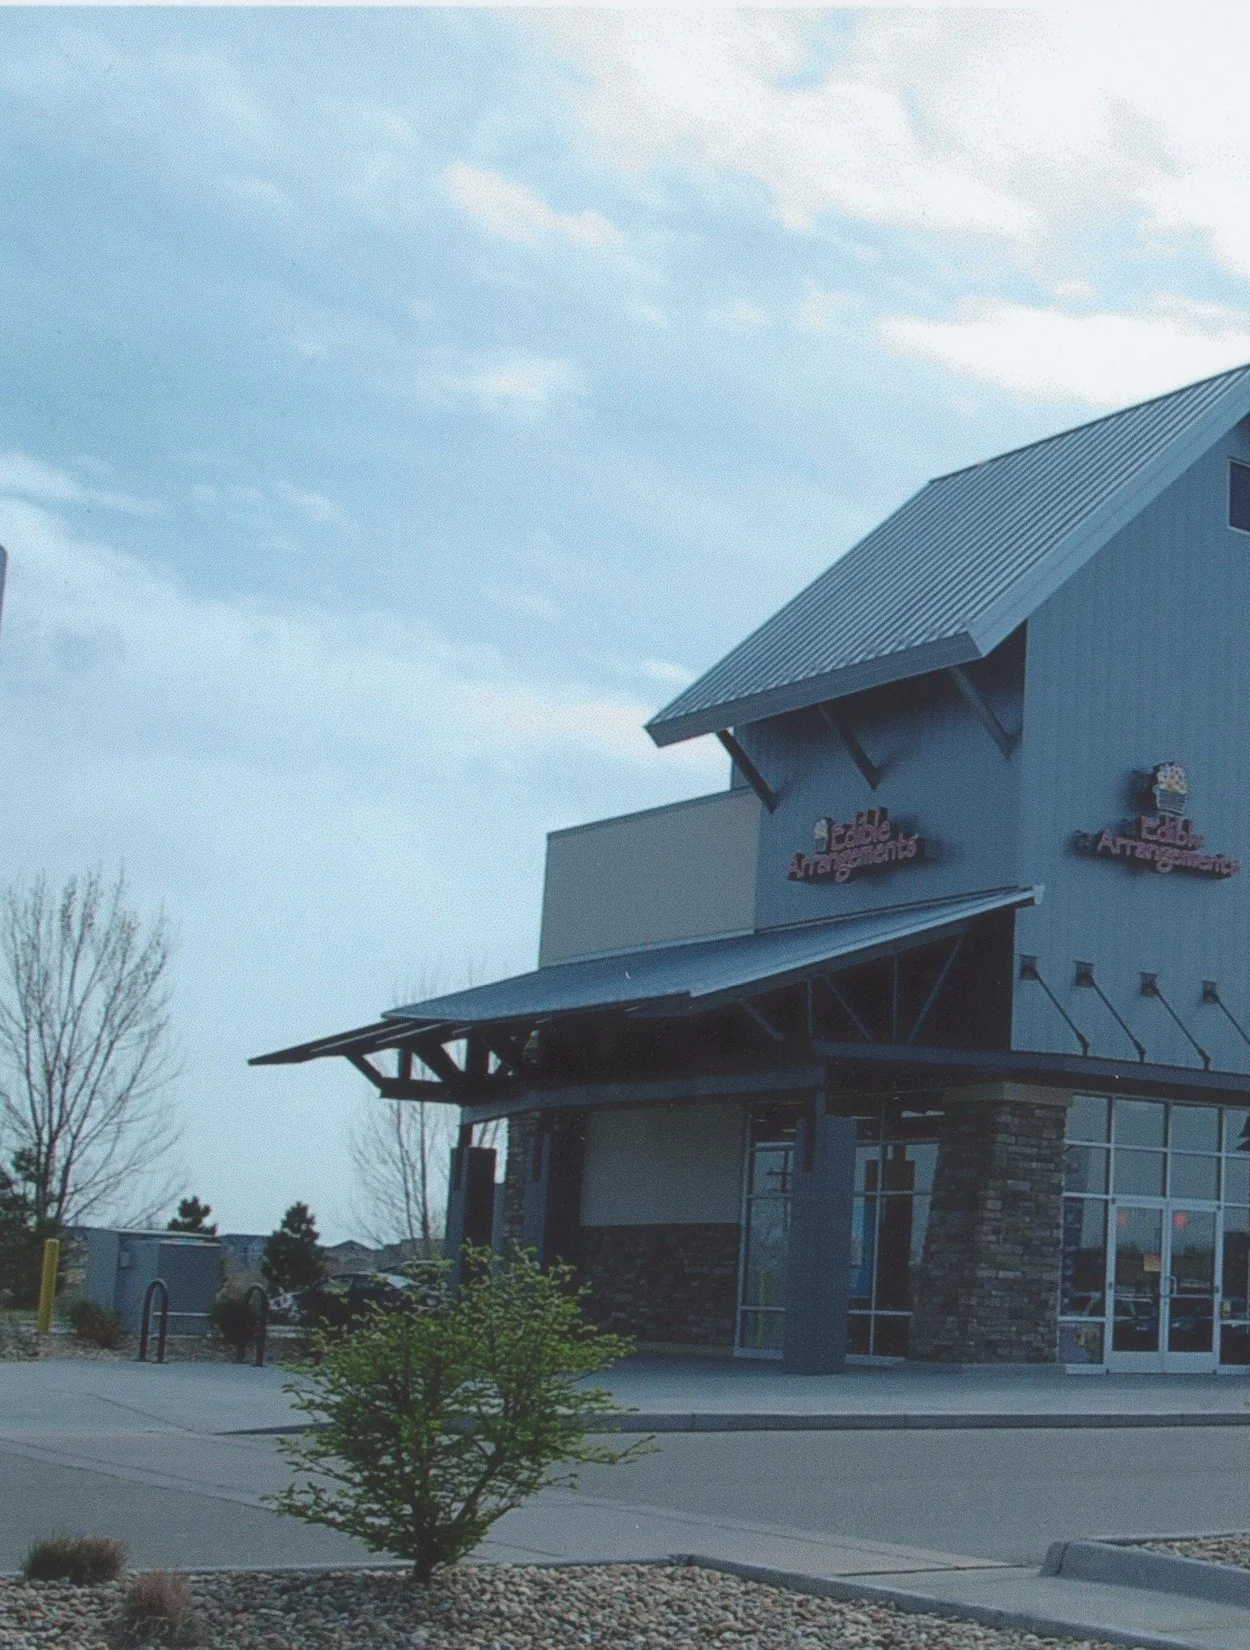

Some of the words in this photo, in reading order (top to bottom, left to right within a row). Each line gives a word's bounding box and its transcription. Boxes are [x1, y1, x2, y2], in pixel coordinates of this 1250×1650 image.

[830, 807, 891, 851] Edible
[1140, 815, 1204, 850] Edible
[788, 832, 919, 883] Arrangements
[1097, 829, 1239, 876] Arrangements
